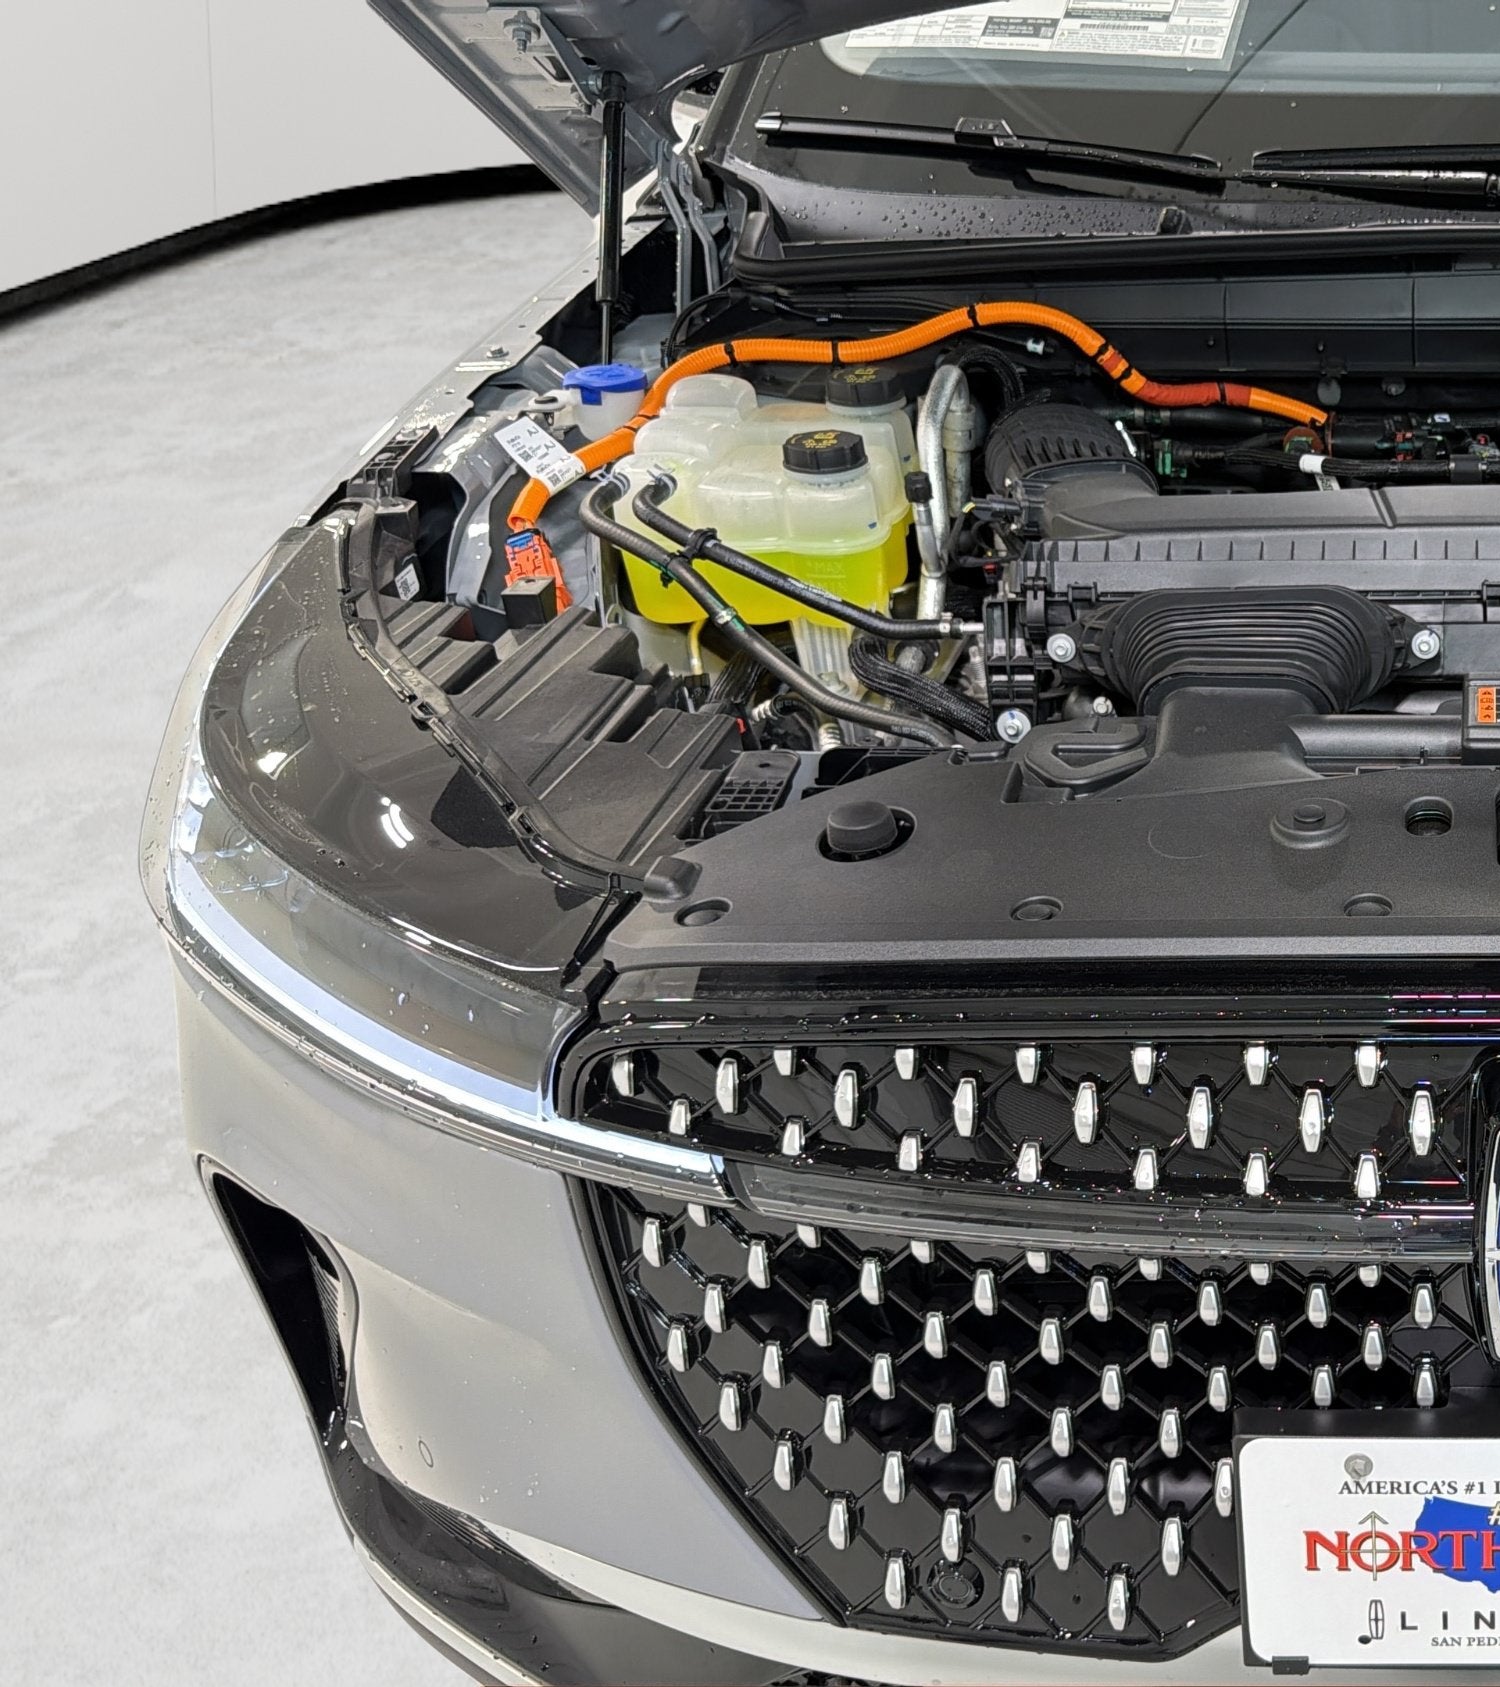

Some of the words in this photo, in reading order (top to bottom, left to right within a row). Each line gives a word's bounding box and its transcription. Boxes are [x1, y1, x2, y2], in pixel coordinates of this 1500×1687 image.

[1338, 1479, 1458, 1495] AMERICA'S
[1464, 1480, 1486, 1494] #1
[1431, 1636, 1462, 1647] SAN
